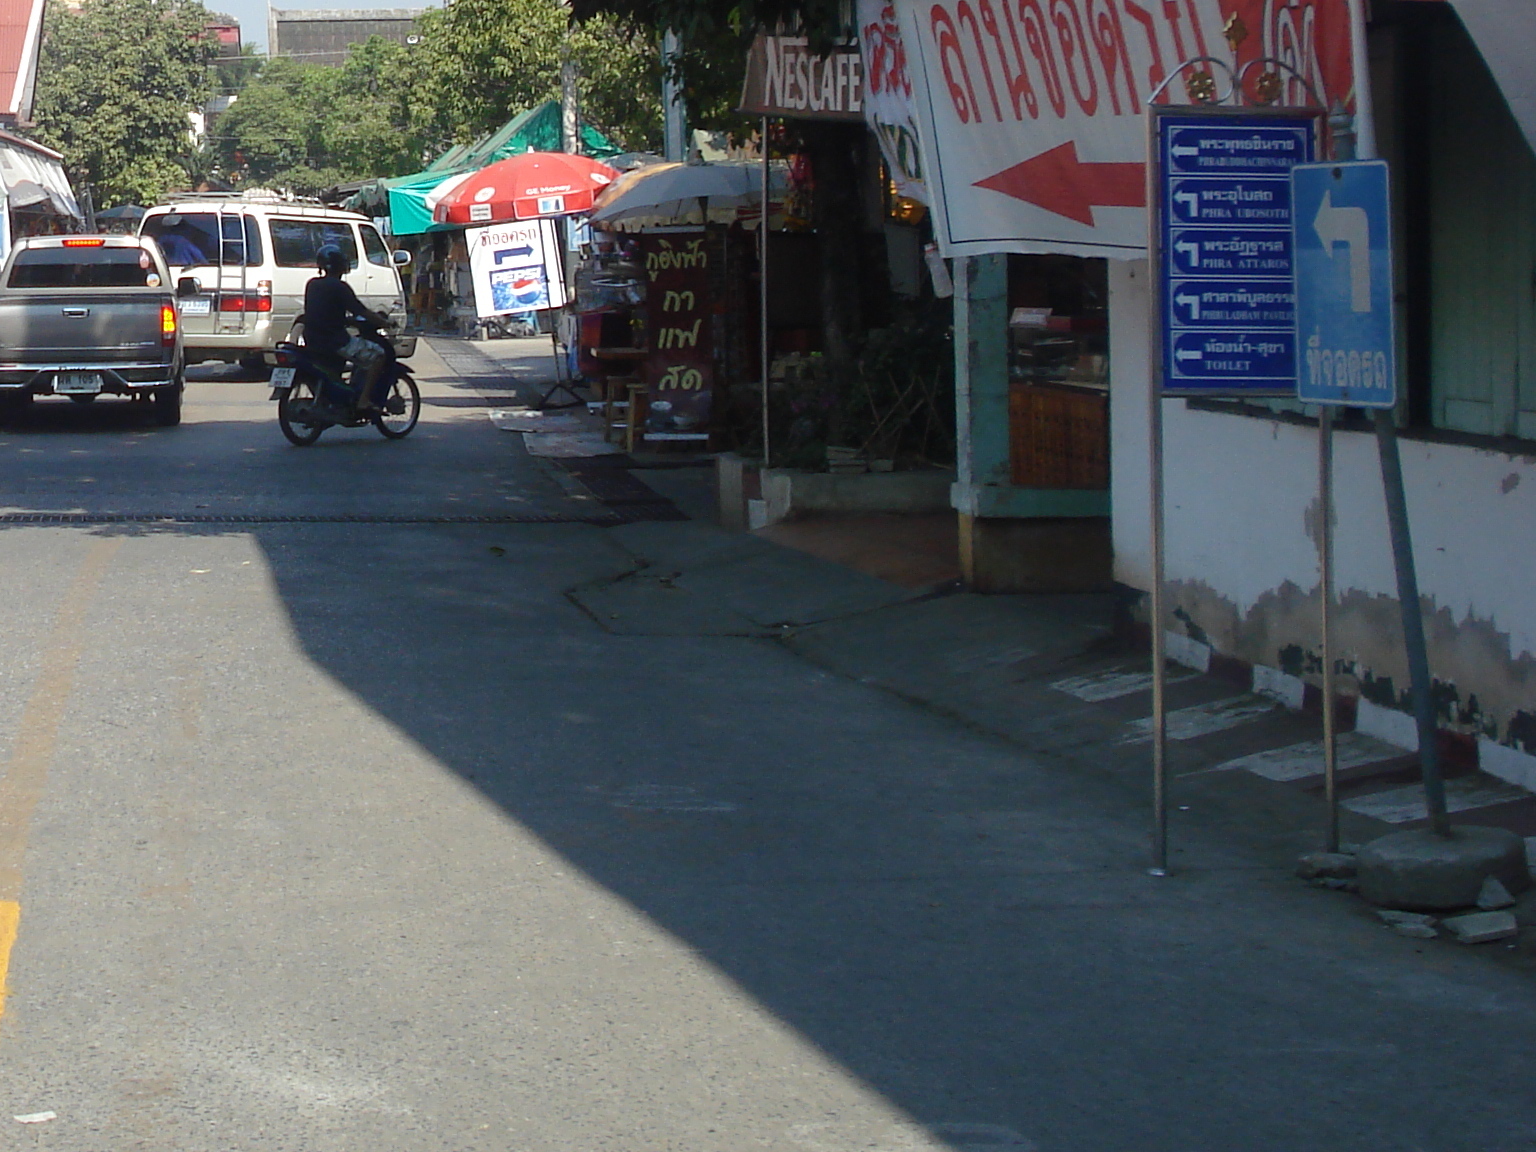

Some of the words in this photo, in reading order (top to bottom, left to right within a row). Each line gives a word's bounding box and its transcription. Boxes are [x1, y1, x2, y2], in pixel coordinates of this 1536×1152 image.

[1201, 208, 1231, 219] PHRA
[1203, 258, 1232, 269] PHRA
[1238, 258, 1290, 269] ATTAROS
[1204, 360, 1252, 371] TOILET
